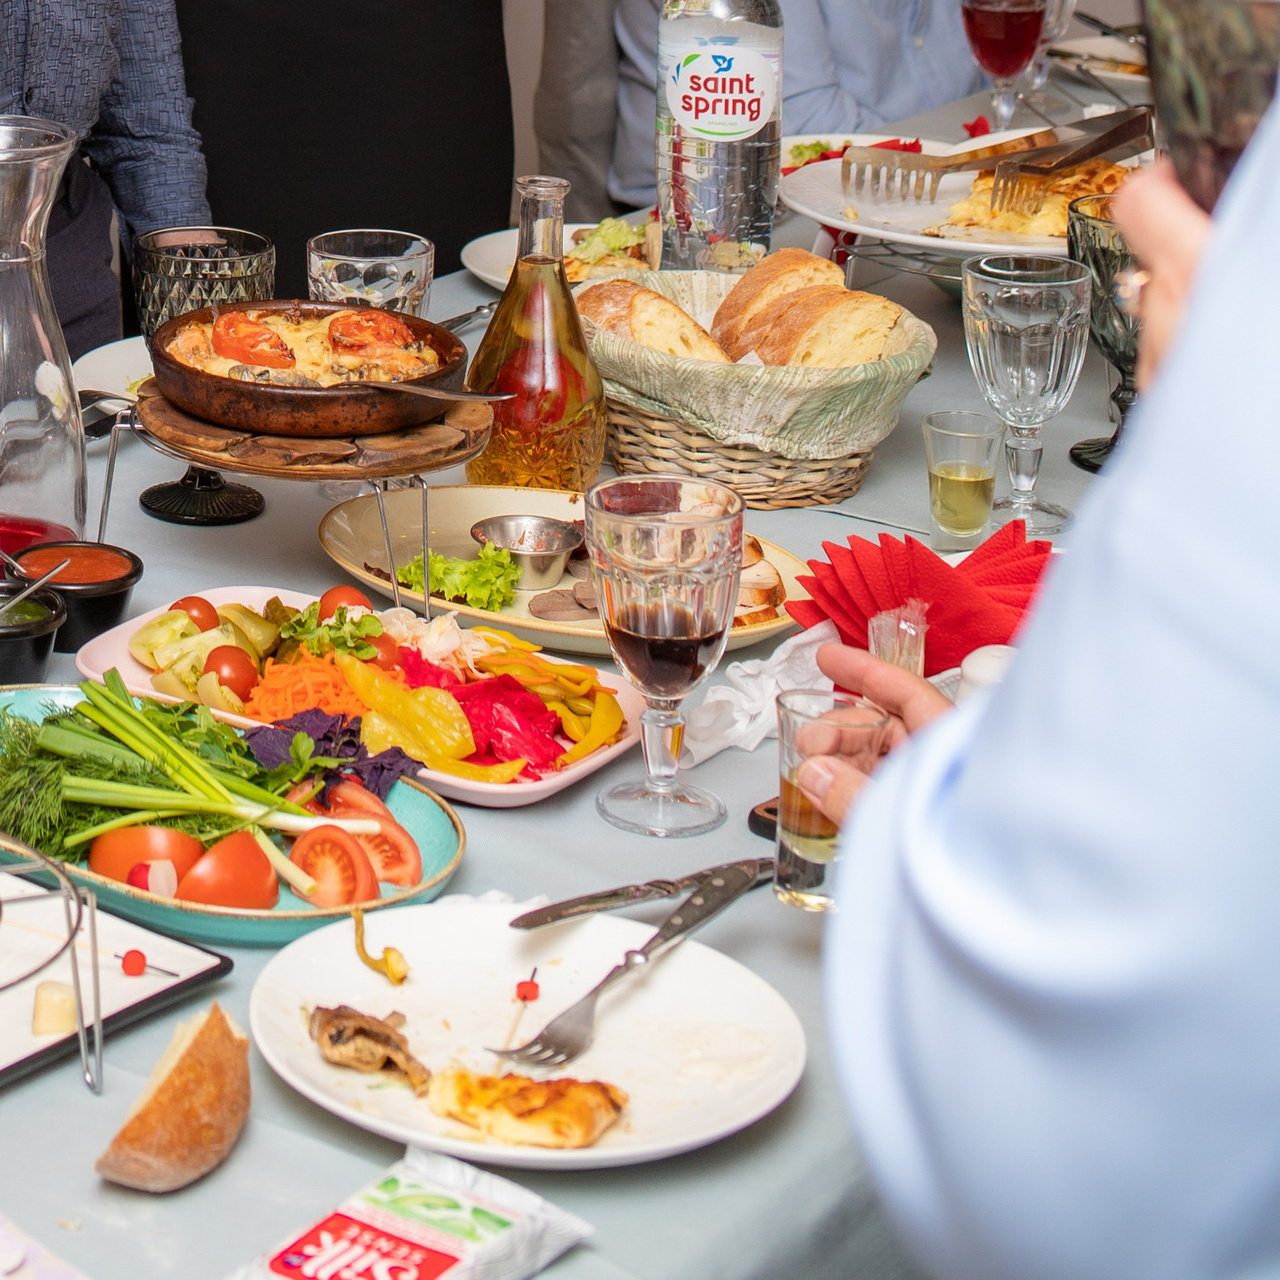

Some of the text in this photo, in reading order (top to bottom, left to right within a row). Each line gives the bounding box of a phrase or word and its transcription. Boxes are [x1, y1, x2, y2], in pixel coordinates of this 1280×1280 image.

[689, 73, 755, 94] saint
[681, 94, 761, 122] spring
[342, 1224, 427, 1265] SENSE
